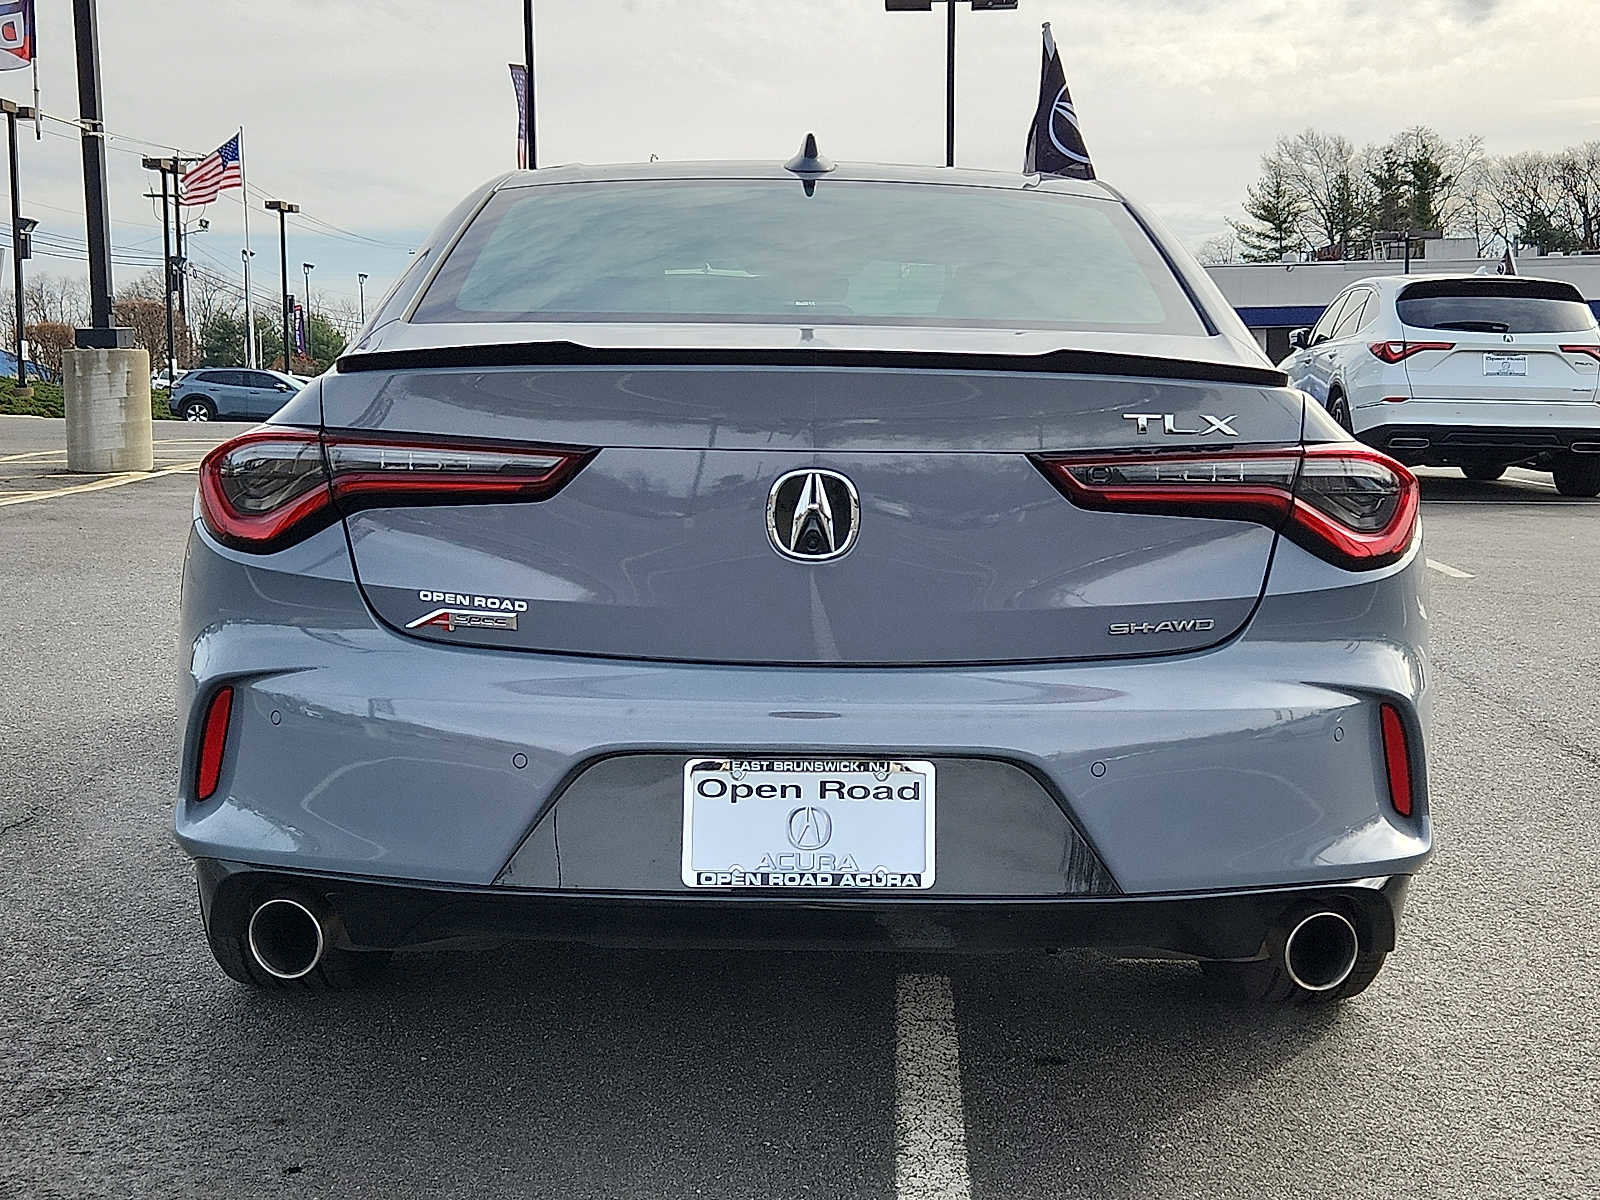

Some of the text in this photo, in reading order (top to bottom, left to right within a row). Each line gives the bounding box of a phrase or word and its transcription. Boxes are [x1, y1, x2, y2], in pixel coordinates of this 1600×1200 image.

[1122, 413, 1239, 436] TLX
[419, 590, 528, 612] OPEN ROAD
[1109, 618, 1215, 635] SH-AWD
[732, 761, 770, 772] EAST
[868, 761, 889, 772] NJ
[697, 778, 920, 804] Open Road
[755, 852, 860, 872] ACURA
[700, 872, 919, 887] OPEN ROAD ACURA
